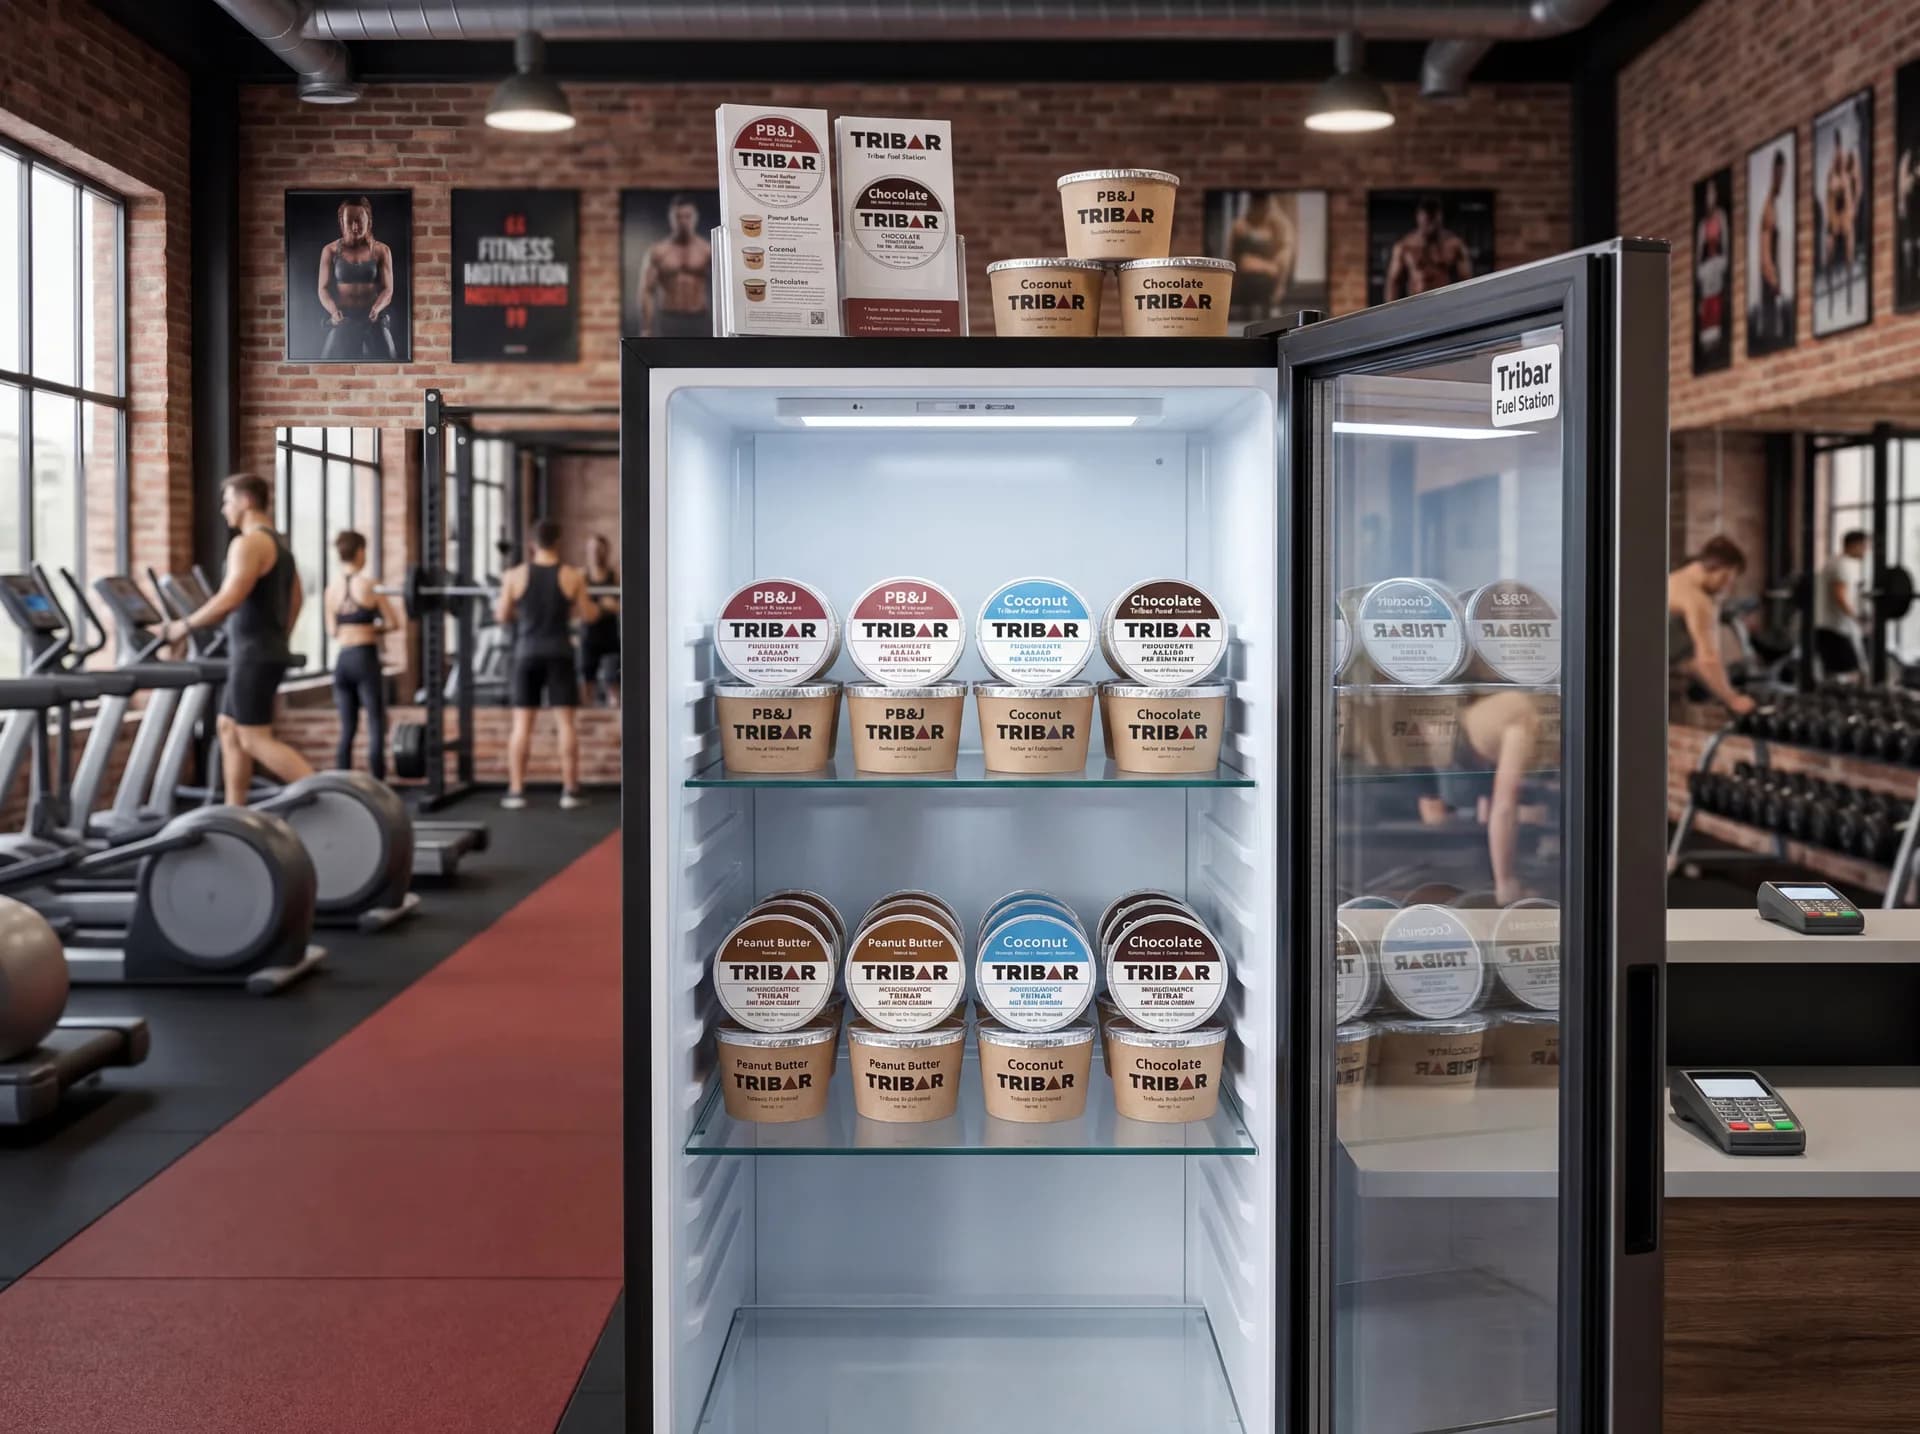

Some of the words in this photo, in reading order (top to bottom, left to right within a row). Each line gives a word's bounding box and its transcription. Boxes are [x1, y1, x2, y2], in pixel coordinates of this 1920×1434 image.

[756, 124, 794, 138] PB&J
[850, 131, 942, 150] TRIBAR
[738, 152, 816, 170] TRIBAR
[868, 188, 928, 200] Chocolate
[1096, 190, 1135, 202] PB&J
[860, 212, 938, 229] TRIBAR
[1077, 208, 1154, 224] TRIBAR
[478, 237, 554, 261] FITNESS
[1020, 279, 1072, 290] Coconut
[1142, 277, 1204, 289] Chocolate
[1008, 294, 1085, 310] TRIBAR
[1134, 293, 1212, 310] TRIBAR
[1497, 361, 1552, 391] Tribar
[1496, 396, 1516, 415] Fuel
[1518, 392, 1554, 411] Station
[753, 591, 796, 604] PB&J
[885, 591, 927, 604] PB&J
[1004, 594, 1068, 606] Coconut
[1131, 594, 1201, 606] Chocolate
[730, 622, 816, 638] TRIBAR
[862, 622, 948, 638] TRIBAR
[992, 622, 1079, 638] TRIBAR
[1124, 622, 1211, 638] TRIBAR
[752, 708, 792, 720] PB&J
[885, 708, 924, 720] PB&J
[1009, 709, 1062, 720] Coconut
[1137, 709, 1200, 720] Chocolate
[733, 724, 812, 740] TRIBAR
[865, 724, 944, 740] TRIBAR
[997, 724, 1075, 740] TRIBAR
[1128, 724, 1208, 740] TRIBAR
[737, 938, 774, 948] Peanut
[777, 938, 811, 948] Butter
[868, 938, 906, 948] Peanut
[909, 938, 943, 948] Butter
[1003, 936, 1068, 948] Coconut
[1129, 936, 1202, 948] Chocolate
[729, 965, 816, 980] TRIBAR
[862, 965, 948, 980] TRIBAR
[992, 965, 1079, 980] TRIBAR
[1124, 965, 1210, 980] TRIBAR
[736, 1059, 772, 1070] Peanut
[775, 1059, 808, 1070] Butter
[869, 1059, 905, 1070] Peanut
[908, 1059, 940, 1070] Butter
[1008, 1059, 1063, 1070] Coconut
[1136, 1058, 1202, 1070] Chocolate
[734, 1072, 812, 1090] TRIBAR
[866, 1072, 943, 1090] TRIBAR
[997, 1072, 1074, 1090] TRIBAR
[1129, 1072, 1207, 1090] TRIBAR
